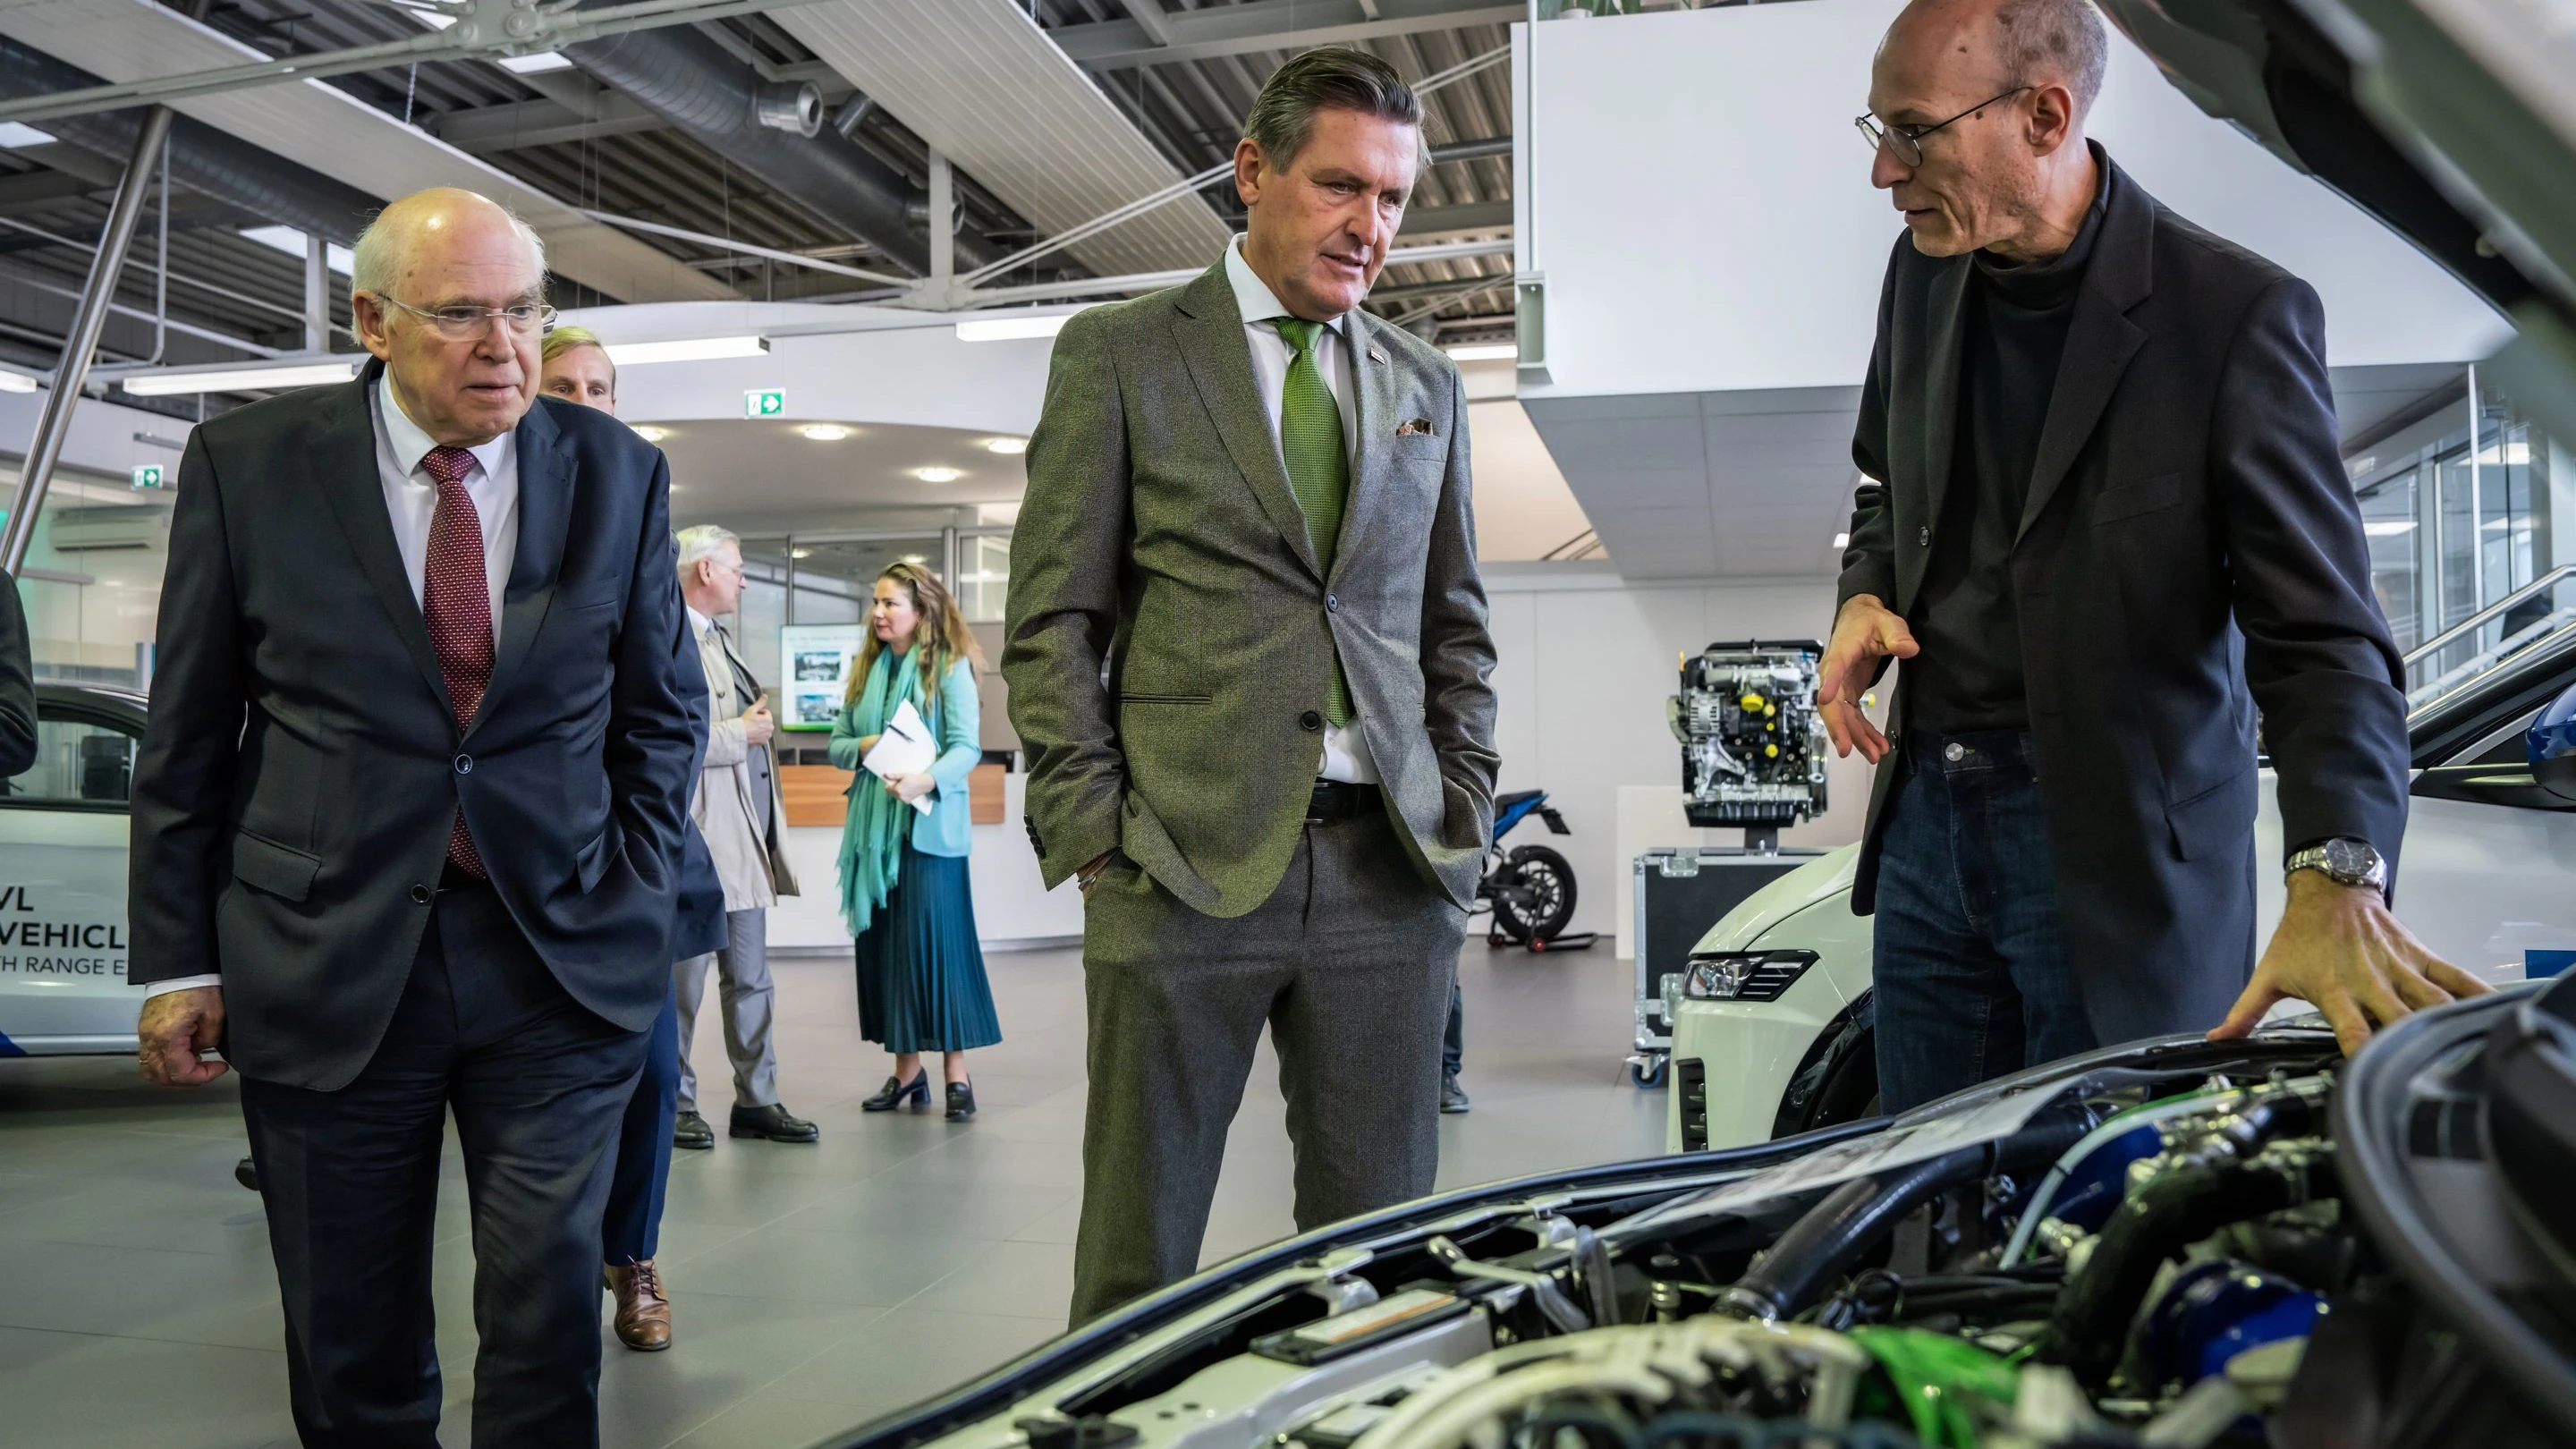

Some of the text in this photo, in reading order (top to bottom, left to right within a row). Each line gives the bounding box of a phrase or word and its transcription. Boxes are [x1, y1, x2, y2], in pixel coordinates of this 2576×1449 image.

[0, 922, 126, 950] VEHICL
[0, 956, 127, 975] H RANGE E
